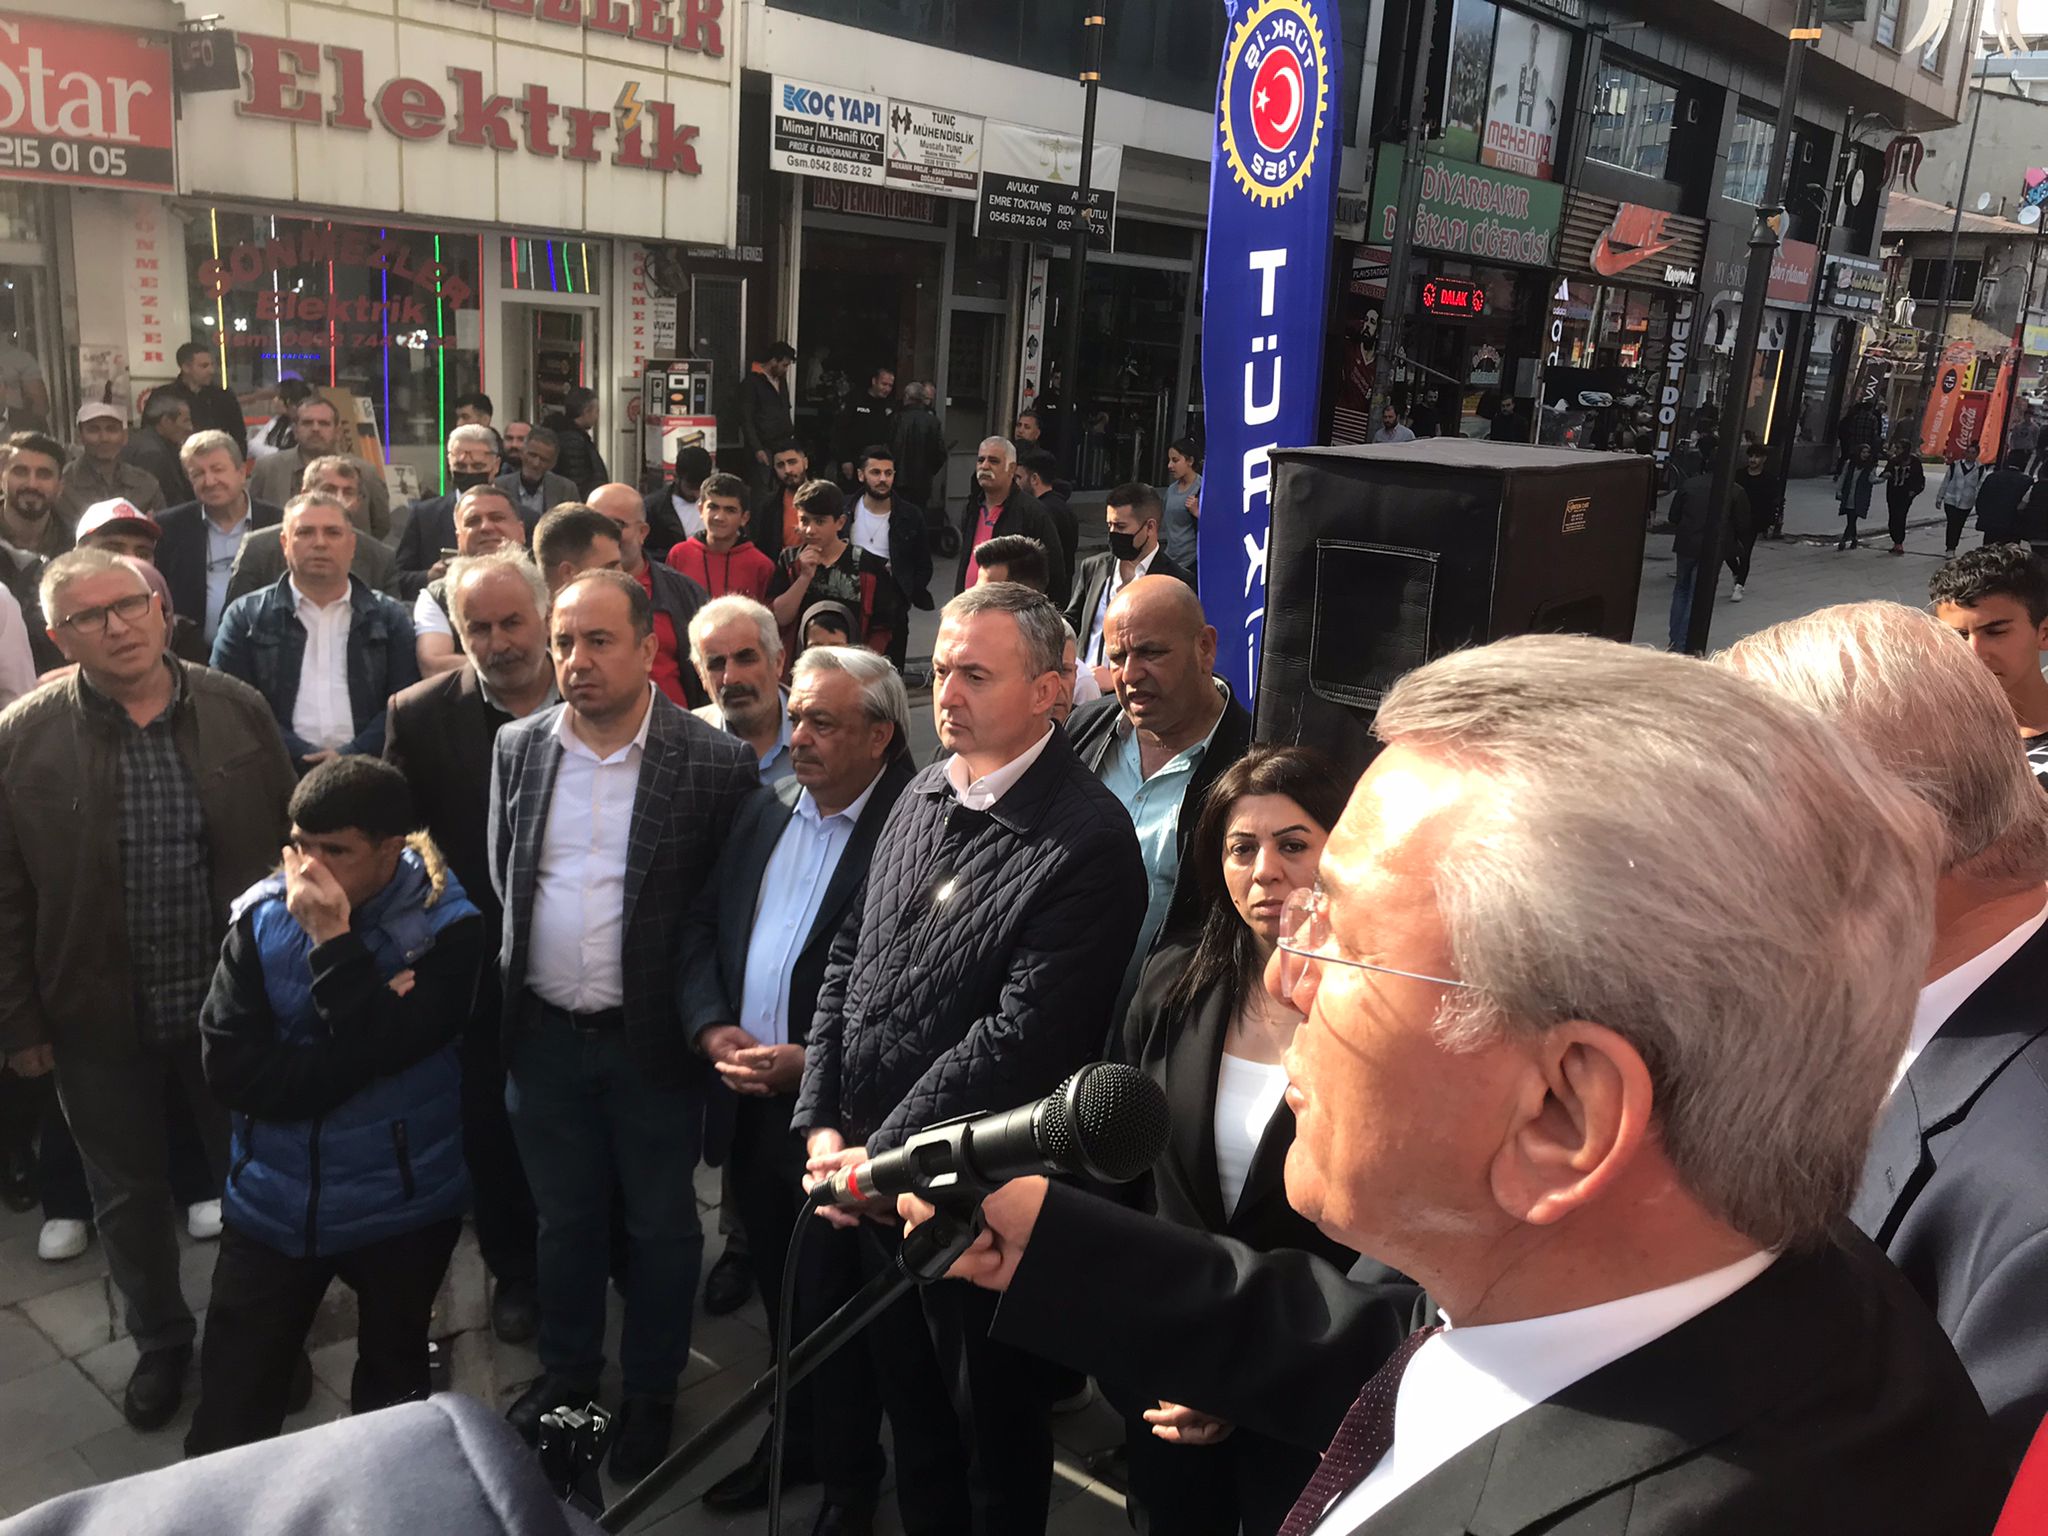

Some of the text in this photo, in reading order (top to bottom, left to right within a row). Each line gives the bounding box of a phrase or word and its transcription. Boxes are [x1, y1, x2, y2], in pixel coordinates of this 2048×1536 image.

[235, 33, 701, 175] Elektrik
[784, 84, 881, 127] KOÇ YAPI
[932, 112, 956, 128] TUNÇ
[782, 119, 880, 151] Mimar M.Hanifi KOÇ
[913, 123, 974, 145] MÜHENDİSLİK
[788, 141, 809, 153] PROJE
[920, 139, 945, 152] Mustafa
[50, 141, 79, 172] 01
[89, 145, 128, 176] 05
[787, 155, 872, 178] Gsm.0542 805 22 82
[1006, 181, 1040, 195] AVUKAT
[1421, 161, 1530, 220] DİYARBAKIR
[988, 195, 1012, 207] EMRE
[1057, 204, 1109, 220] RIDV UTLU
[989, 211, 1047, 228] 0545 874 26 04
[1057, 220, 1072, 231] 053
[1610, 202, 1672, 248] NIKE
[1383, 202, 1468, 252] DĞKAPI
[1470, 217, 1550, 265] CİĞERCİSİ
[1727, 264, 1748, 289] SHO
[256, 290, 428, 324] Elektrik
[1440, 289, 1468, 307] DALAK
[654, 321, 675, 331] VUKAT
[1652, 300, 1693, 469] JUST DO IT
